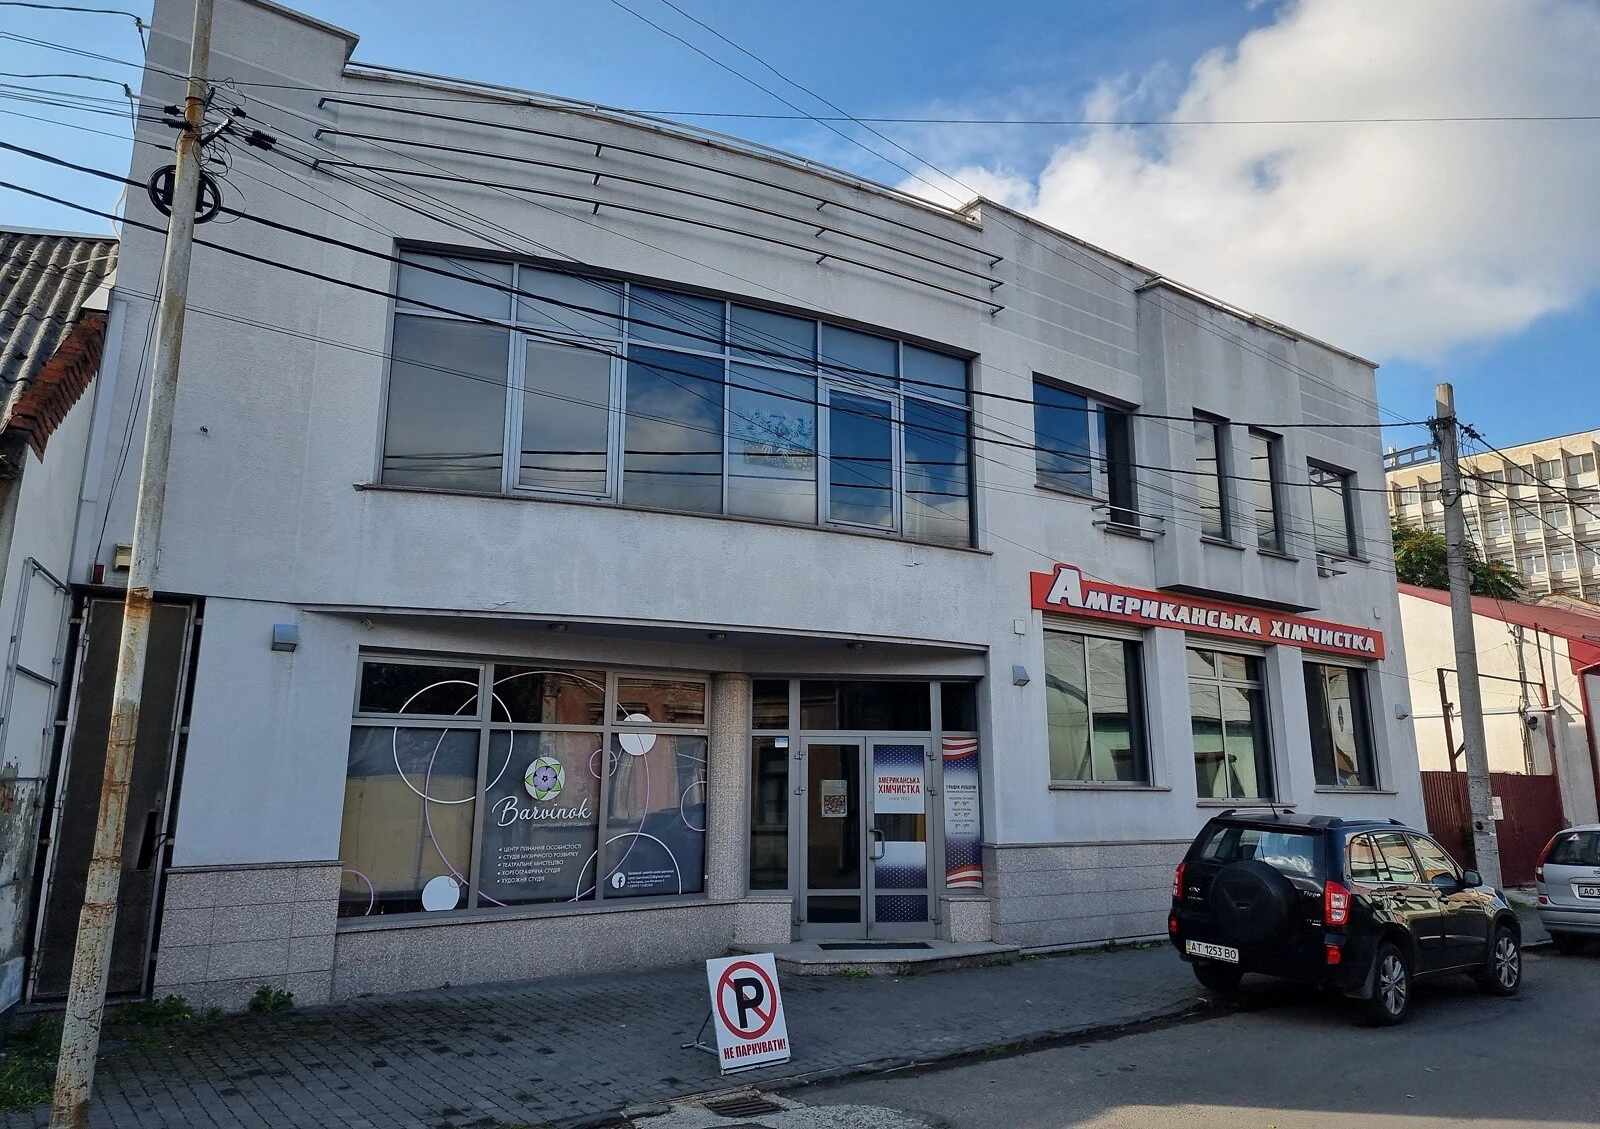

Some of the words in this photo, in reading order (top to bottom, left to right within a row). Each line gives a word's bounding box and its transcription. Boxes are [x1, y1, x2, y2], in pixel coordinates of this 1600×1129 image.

[1270, 619, 1376, 653] ХІМЧИСТКА
[878, 776, 921, 784] АМЕРИКАНСЬКА
[878, 784, 921, 794] ХІМЧИСТКА
[492, 795, 592, 827] Barvinok
[520, 852, 553, 860] МУЗИЧНОГО
[545, 843, 582, 851] ОСОБИСТОСТІ
[1191, 942, 1202, 953] AT
[1204, 944, 1223, 957] 1253
[1224, 947, 1237, 960] BO
[733, 977, 765, 1029] P
[723, 1046, 735, 1060] НЕ
[735, 1038, 787, 1058] ПАРКУВАТИ!
